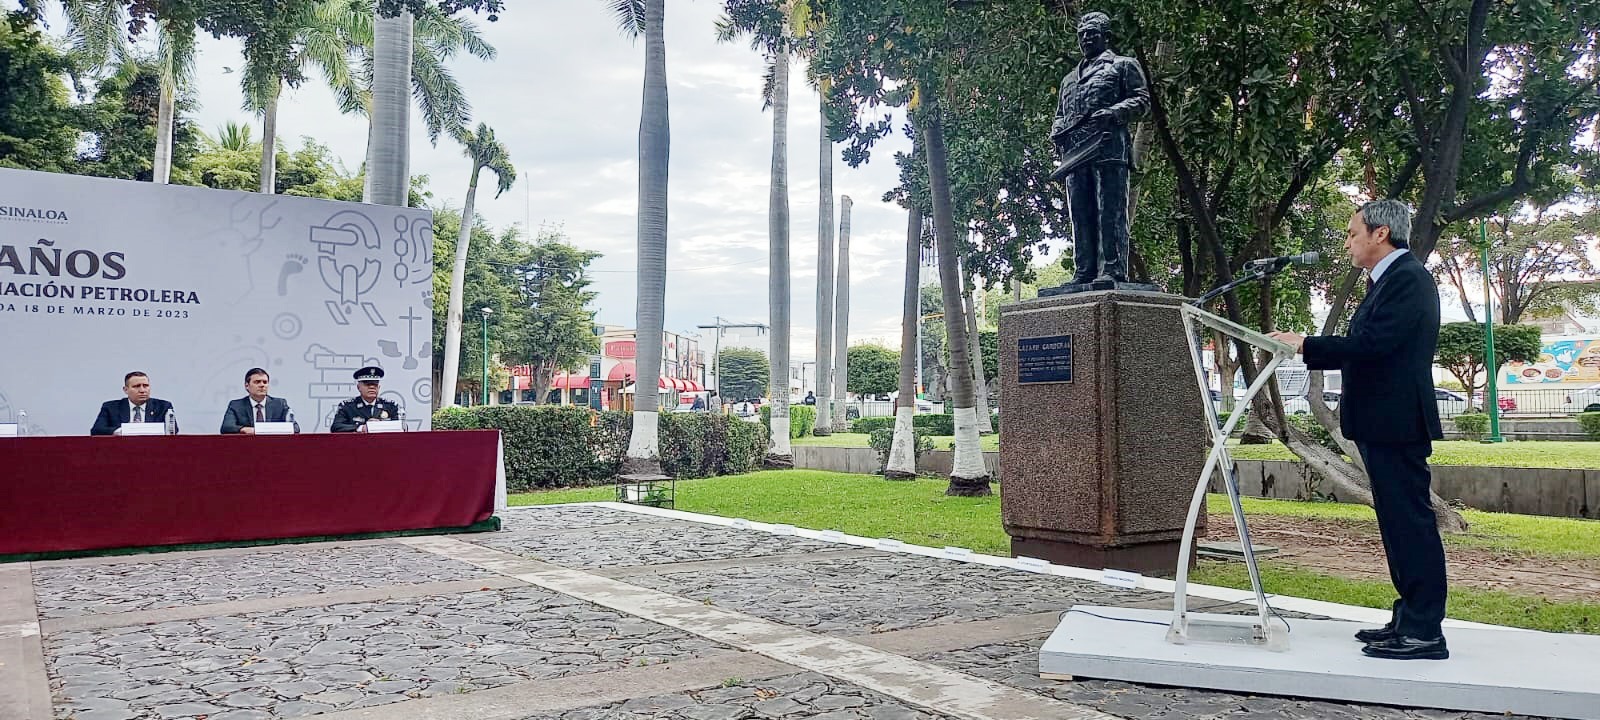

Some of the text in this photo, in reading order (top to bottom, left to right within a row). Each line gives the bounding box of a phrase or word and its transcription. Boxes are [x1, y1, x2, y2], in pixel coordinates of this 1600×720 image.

[0, 206, 68, 221] SINALOA
[0, 238, 126, 280] AÑOS
[0, 281, 200, 305] ACIÓN PETROLERA
[25, 304, 39, 313] 18
[47, 305, 65, 314] DE
[73, 306, 126, 316] MARZO
[132, 308, 151, 317] DE
[156, 309, 189, 319] 2023
